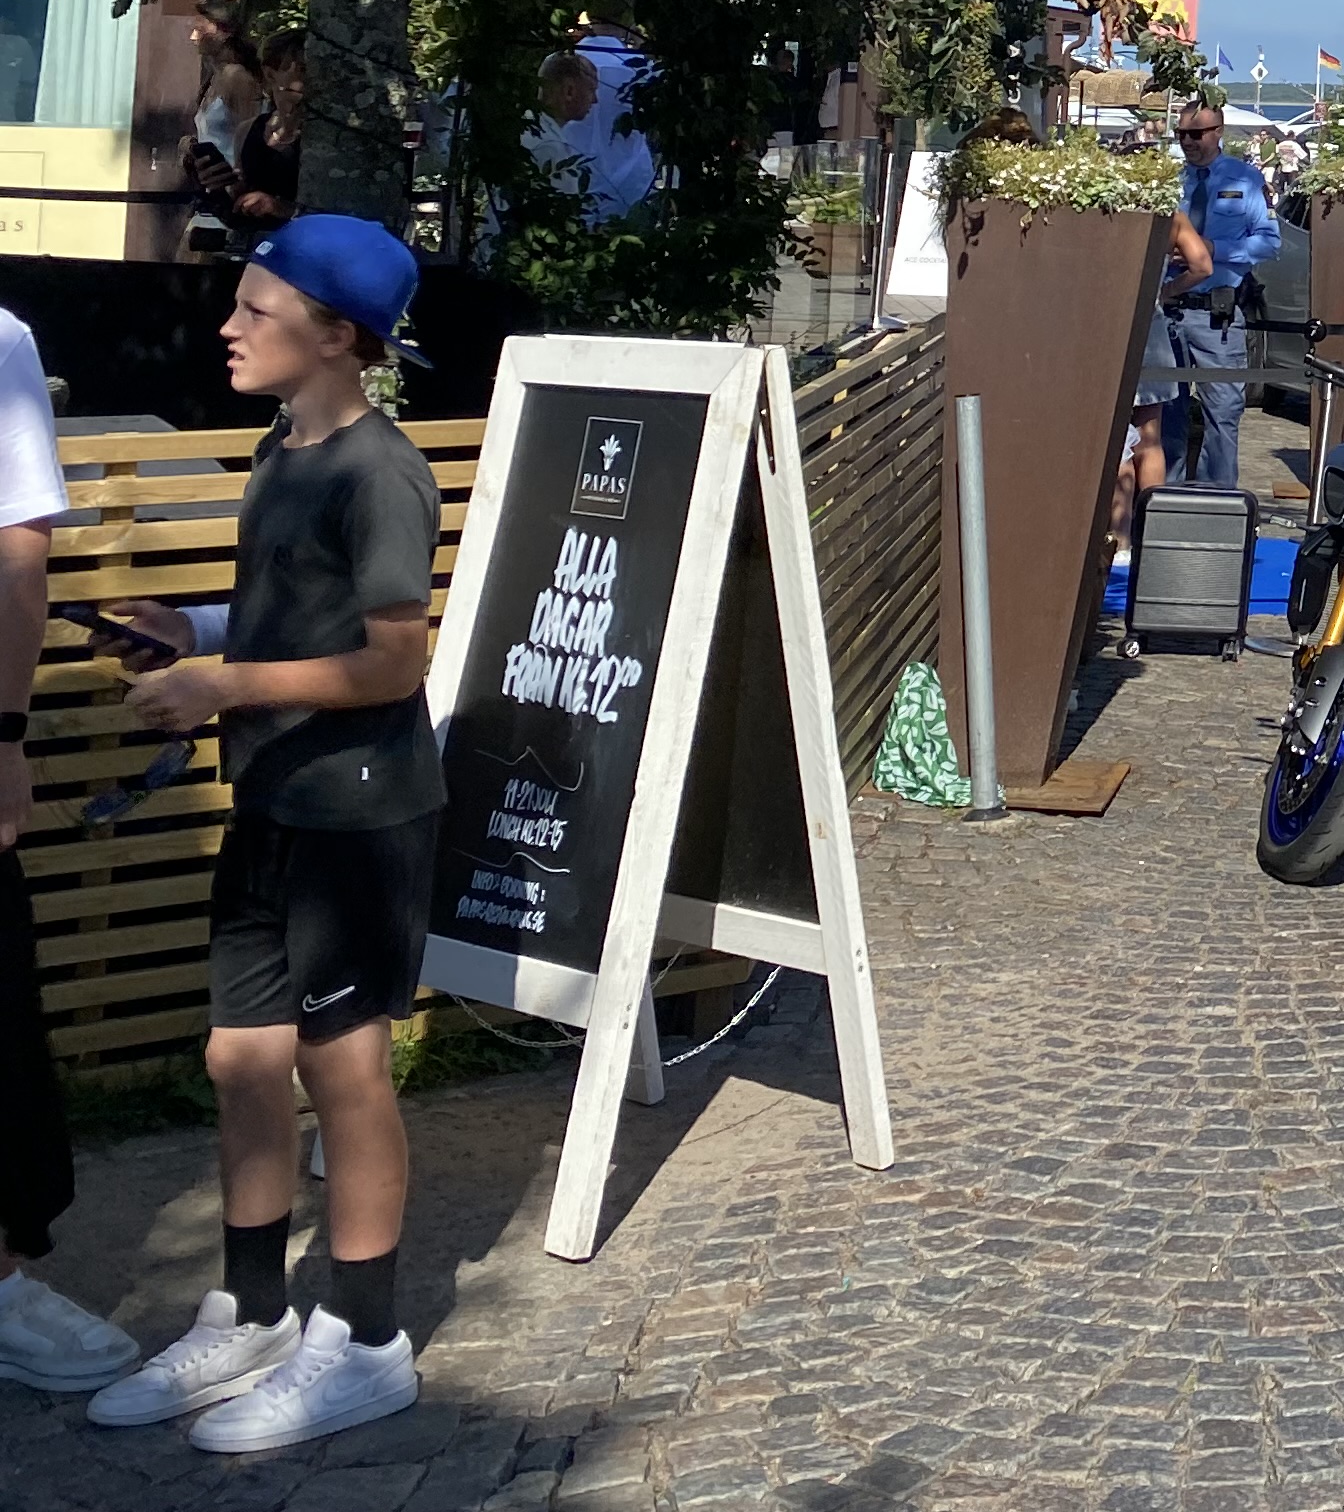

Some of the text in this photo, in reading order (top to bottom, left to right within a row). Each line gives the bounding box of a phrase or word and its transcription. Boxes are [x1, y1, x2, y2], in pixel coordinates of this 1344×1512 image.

[581, 472, 627, 494] PAPAS
[554, 525, 617, 599] ALLA
[528, 588, 614, 658] DAGAR
[501, 642, 563, 708] FRÅN
[486, 809, 523, 842] LUNCH
